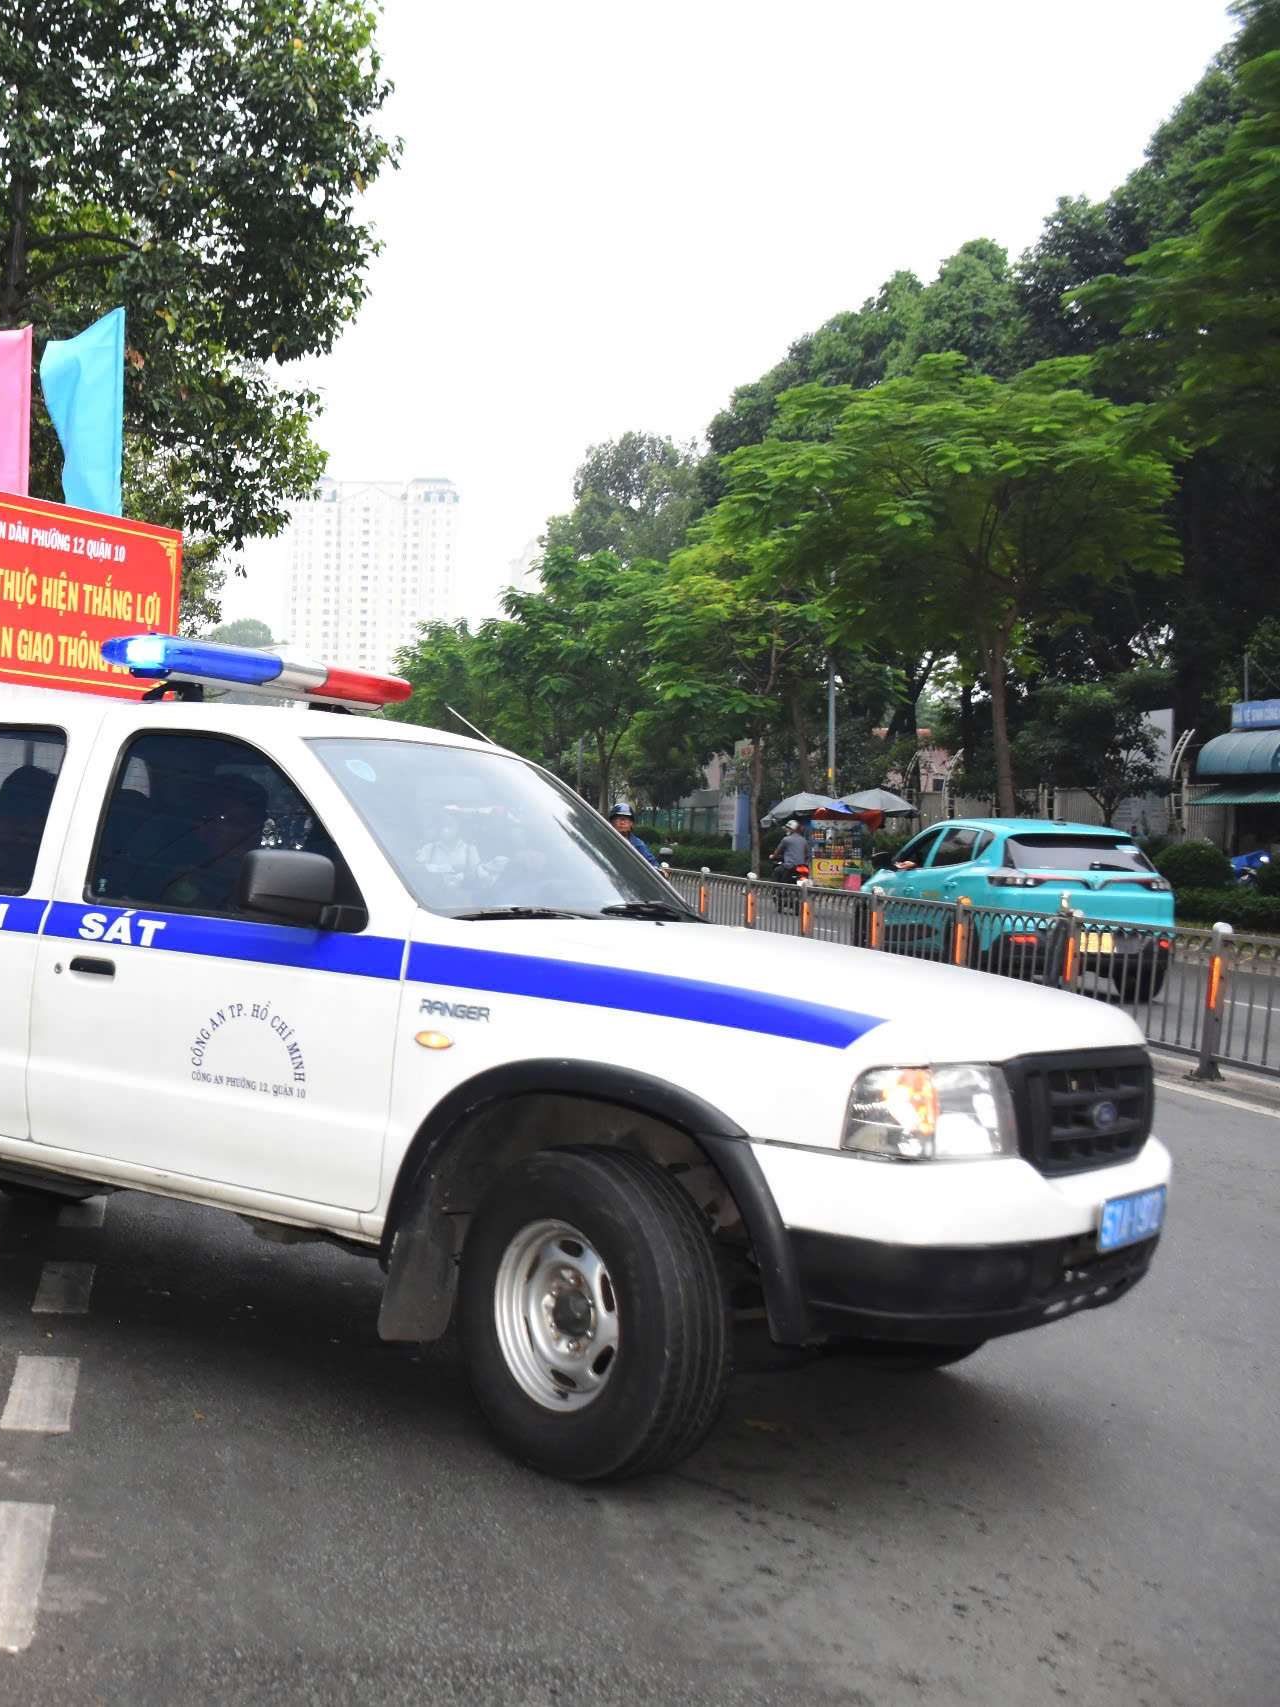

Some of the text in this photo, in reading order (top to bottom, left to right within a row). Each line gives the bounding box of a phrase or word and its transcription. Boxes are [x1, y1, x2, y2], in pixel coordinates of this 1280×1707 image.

[8, 520, 30, 543] DÂN
[31, 527, 71, 552] PHƯỜNG
[72, 536, 85, 555] 12
[87, 538, 112, 562] QUẬN
[113, 544, 126, 563] 10
[41, 571, 79, 616] HIỆN
[83, 574, 132, 622] THẮNG
[135, 591, 161, 631] LỢI
[16, 627, 54, 665] GIAO
[78, 910, 167, 948] SÁT
[419, 998, 490, 1022] RANGER
[190, 1000, 306, 1082] CÔNG AN TP. HỒ CHÍ MINH
[213, 1075, 224, 1085] AN
[296, 1089, 306, 1099] 10
